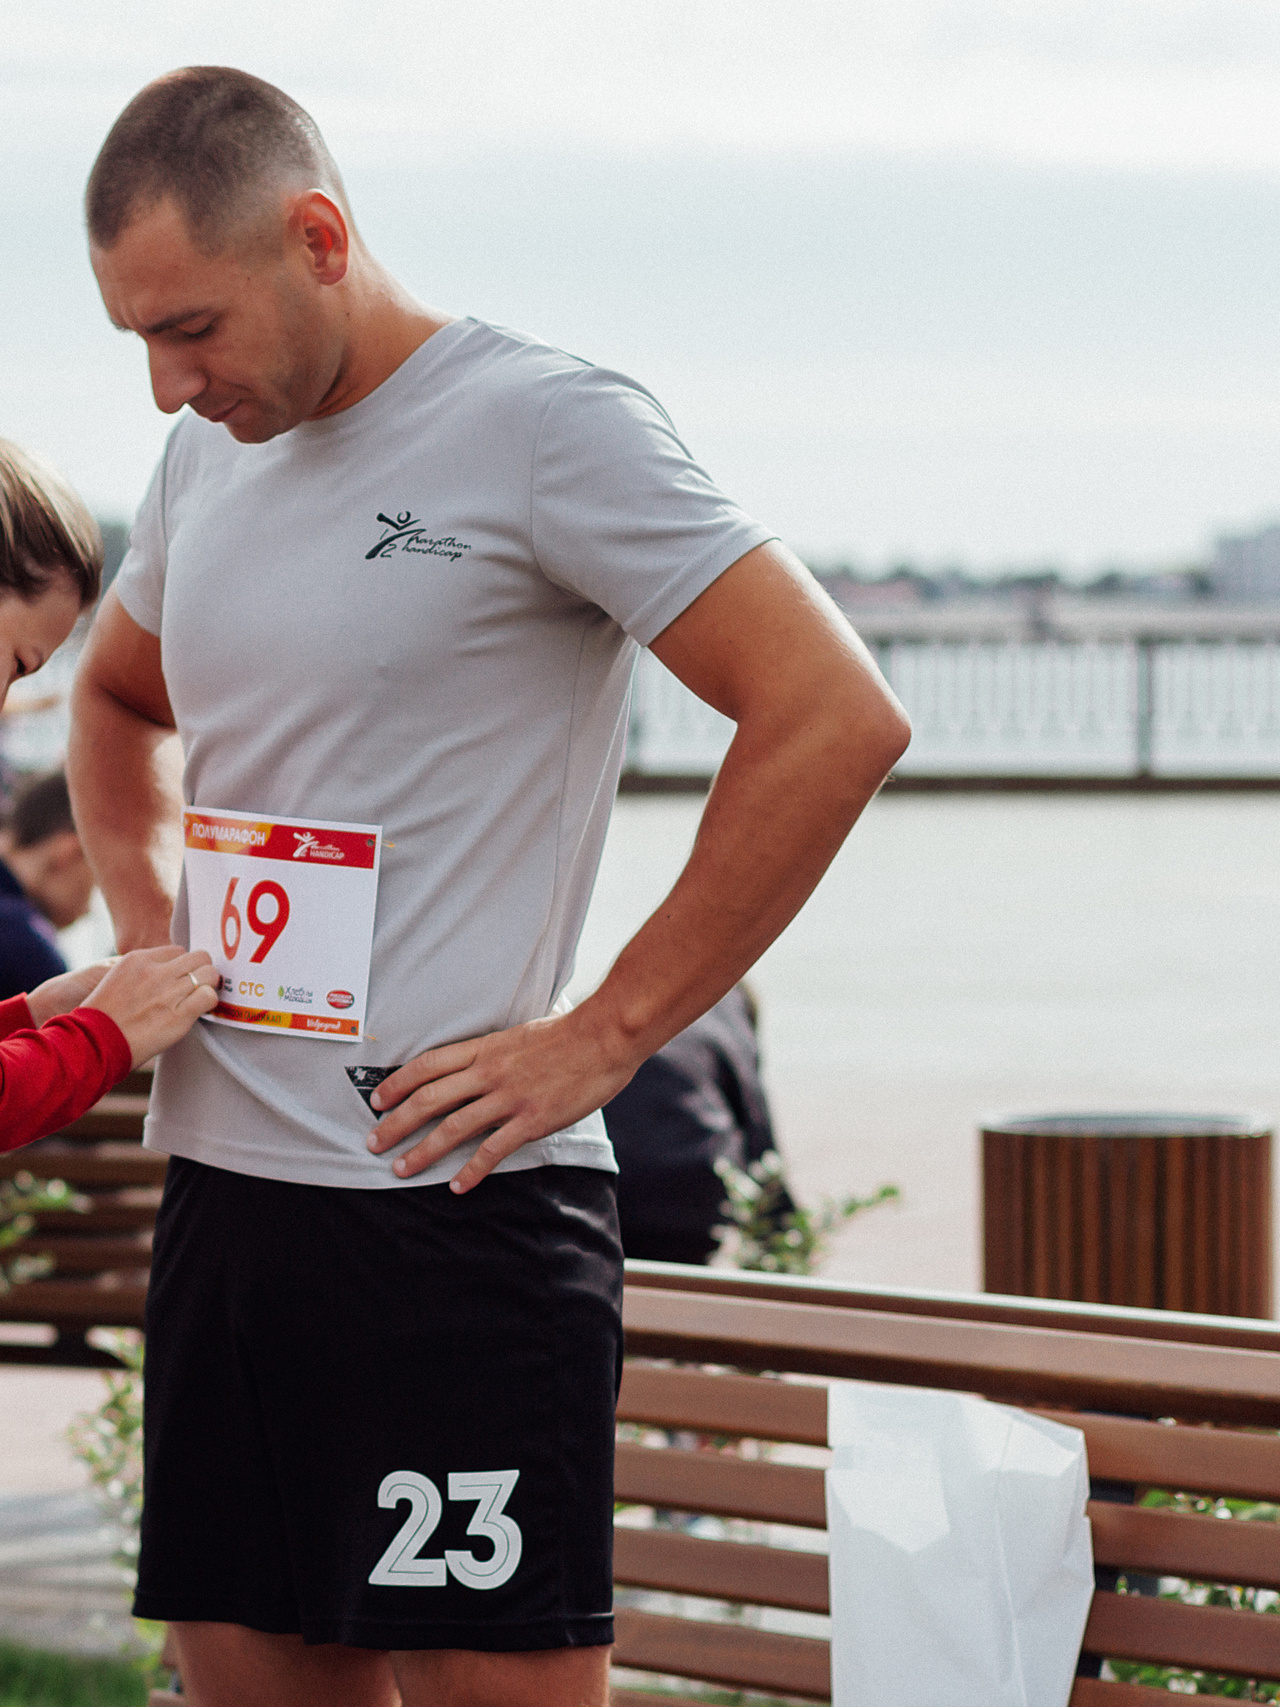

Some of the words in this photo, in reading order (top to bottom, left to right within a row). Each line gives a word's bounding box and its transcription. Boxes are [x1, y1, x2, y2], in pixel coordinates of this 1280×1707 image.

[192, 822, 266, 846] ПОЛУМАРАФОН
[221, 876, 290, 964] 69
[368, 1469, 523, 1590] 23
